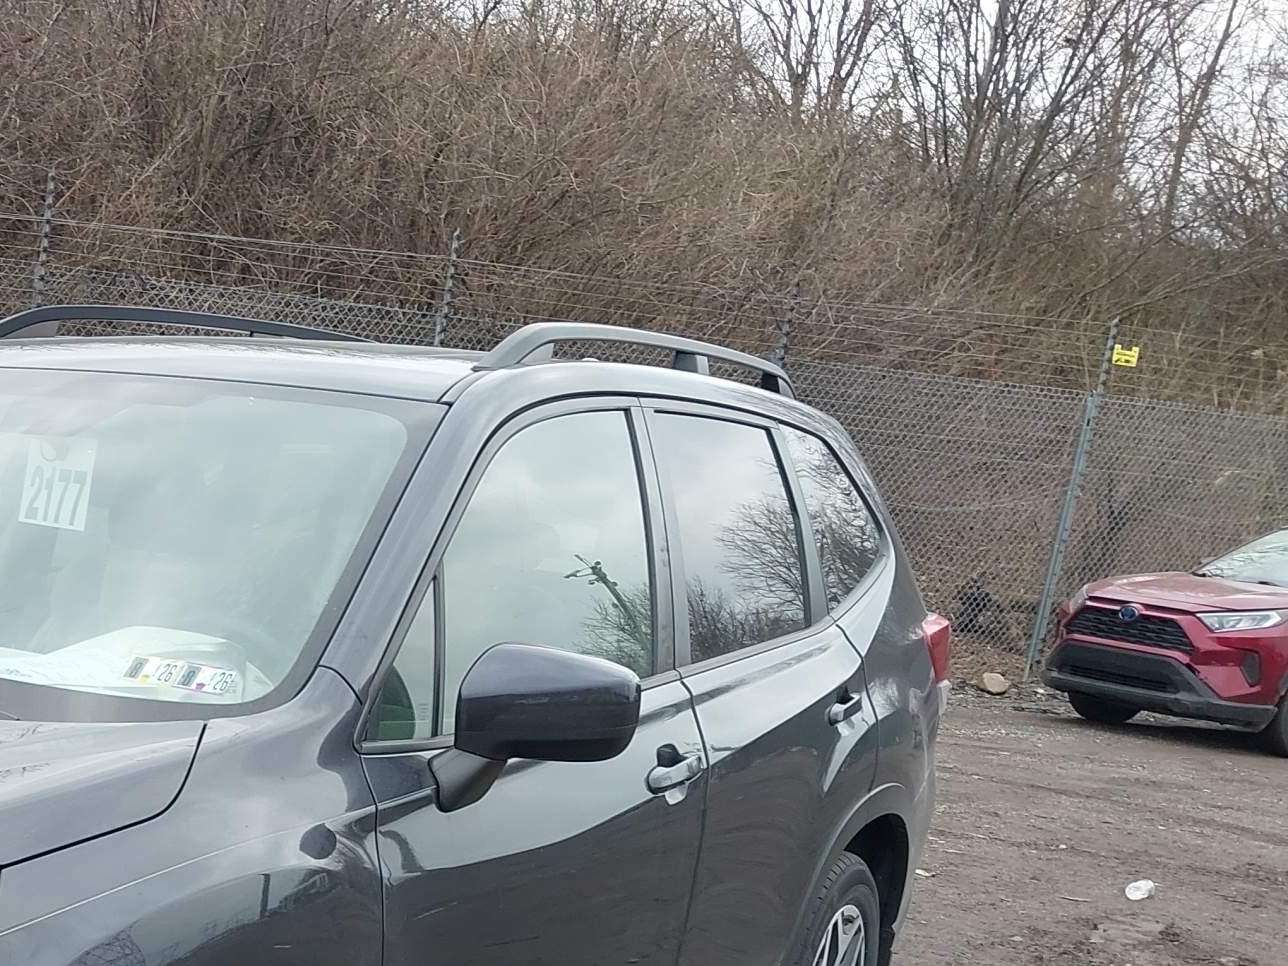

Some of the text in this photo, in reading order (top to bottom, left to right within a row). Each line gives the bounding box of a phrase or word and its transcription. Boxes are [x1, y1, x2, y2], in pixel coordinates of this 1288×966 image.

[23, 464, 89, 527] 2177
[156, 663, 178, 683] 26
[213, 671, 233, 692] 26
